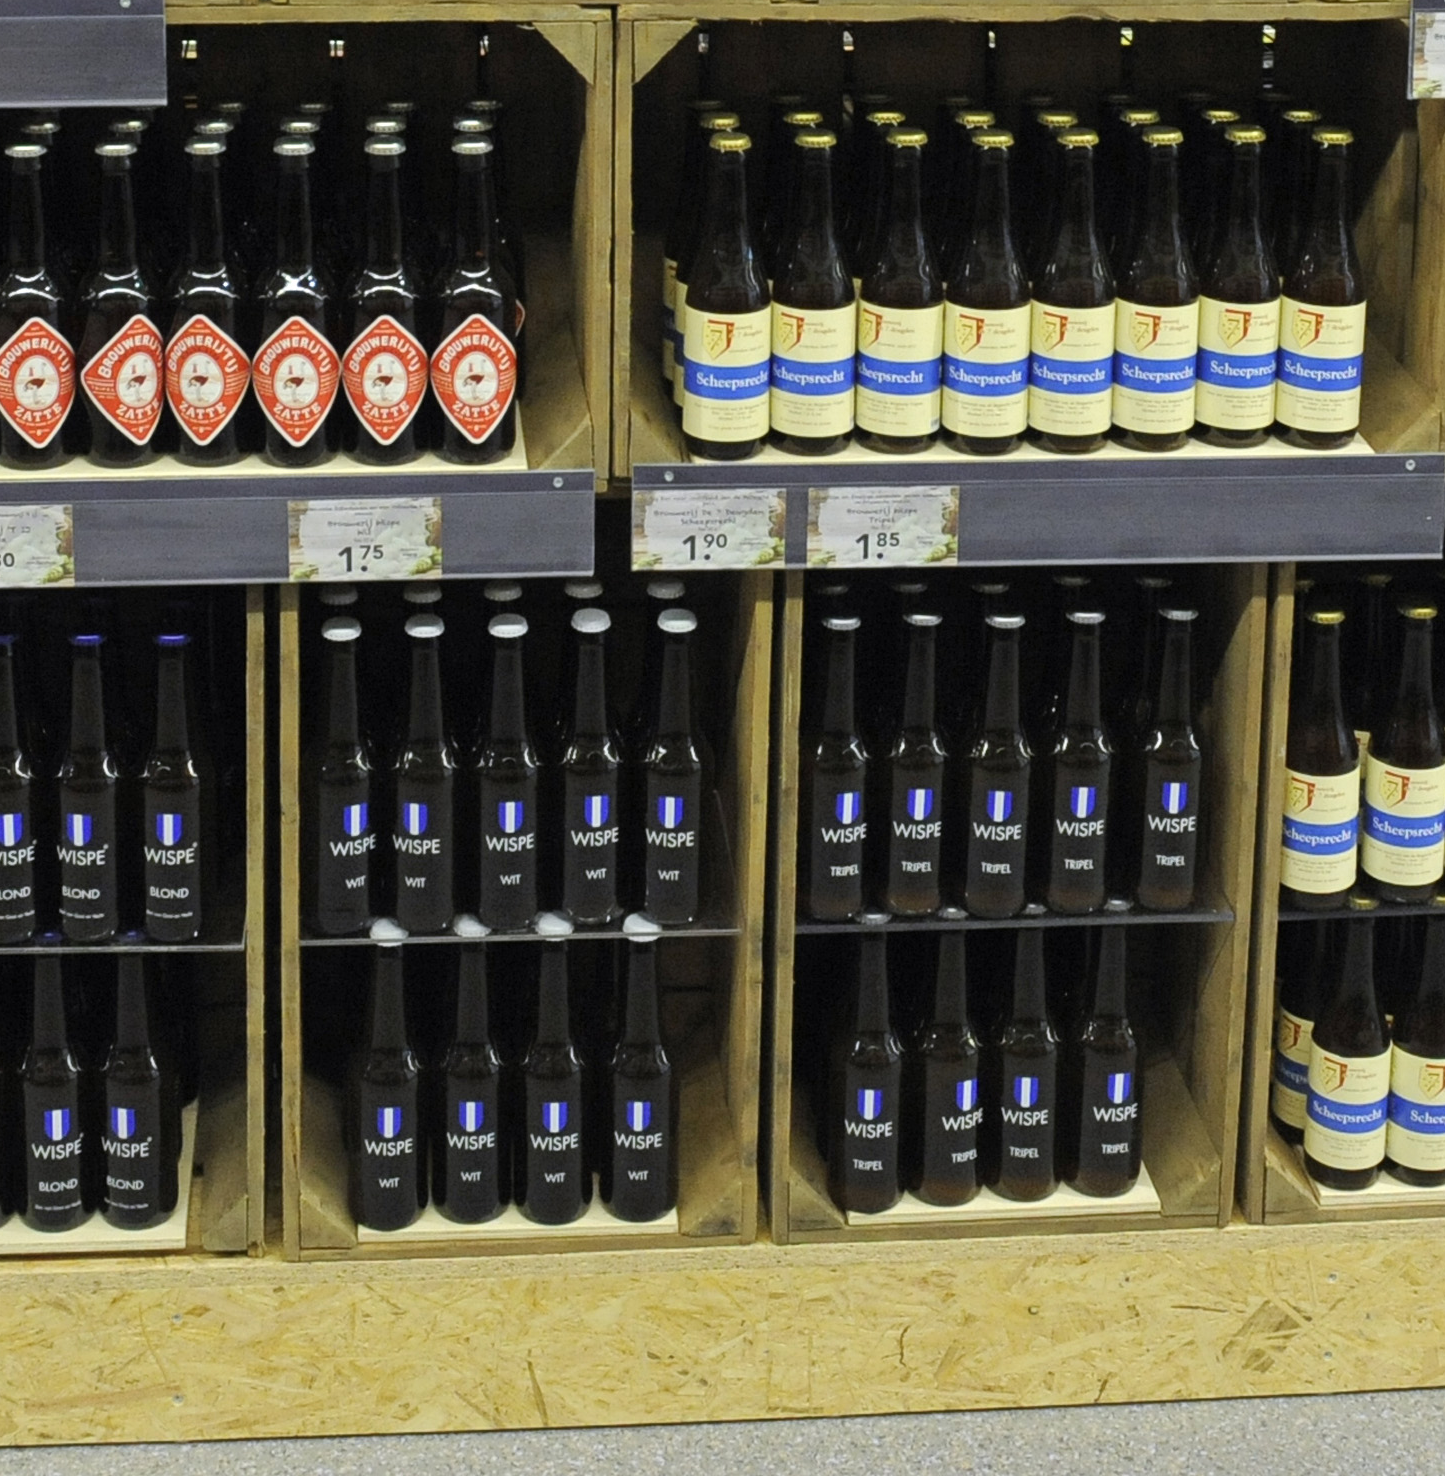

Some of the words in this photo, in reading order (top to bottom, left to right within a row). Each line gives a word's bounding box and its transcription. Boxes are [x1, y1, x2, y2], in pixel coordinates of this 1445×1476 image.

[948, 365, 1022, 390] Scheepsrecht
[1122, 361, 1194, 386] Scheepsrecht
[1284, 357, 1357, 383] Scheepsrecht
[893, 820, 942, 840] WISPE
[1148, 814, 1197, 833] WISPE
[1372, 815, 1444, 839] Scheepsrecht
[486, 832, 535, 852] WISPE
[646, 829, 695, 848] WISPE
[144, 846, 195, 866] WISPE
[1155, 854, 1186, 867] TRIPEL
[658, 869, 680, 881] WIT
[901, 860, 932, 873] TRIPEL
[500, 873, 522, 886] WIT
[149, 886, 190, 899] BLOND
[1001, 1107, 1048, 1126] WISPE
[1312, 1100, 1383, 1124] Scheepsrecht
[365, 1138, 413, 1157] WISPE
[1009, 1146, 1039, 1159] TRIPEL
[379, 1177, 399, 1189] WIT
